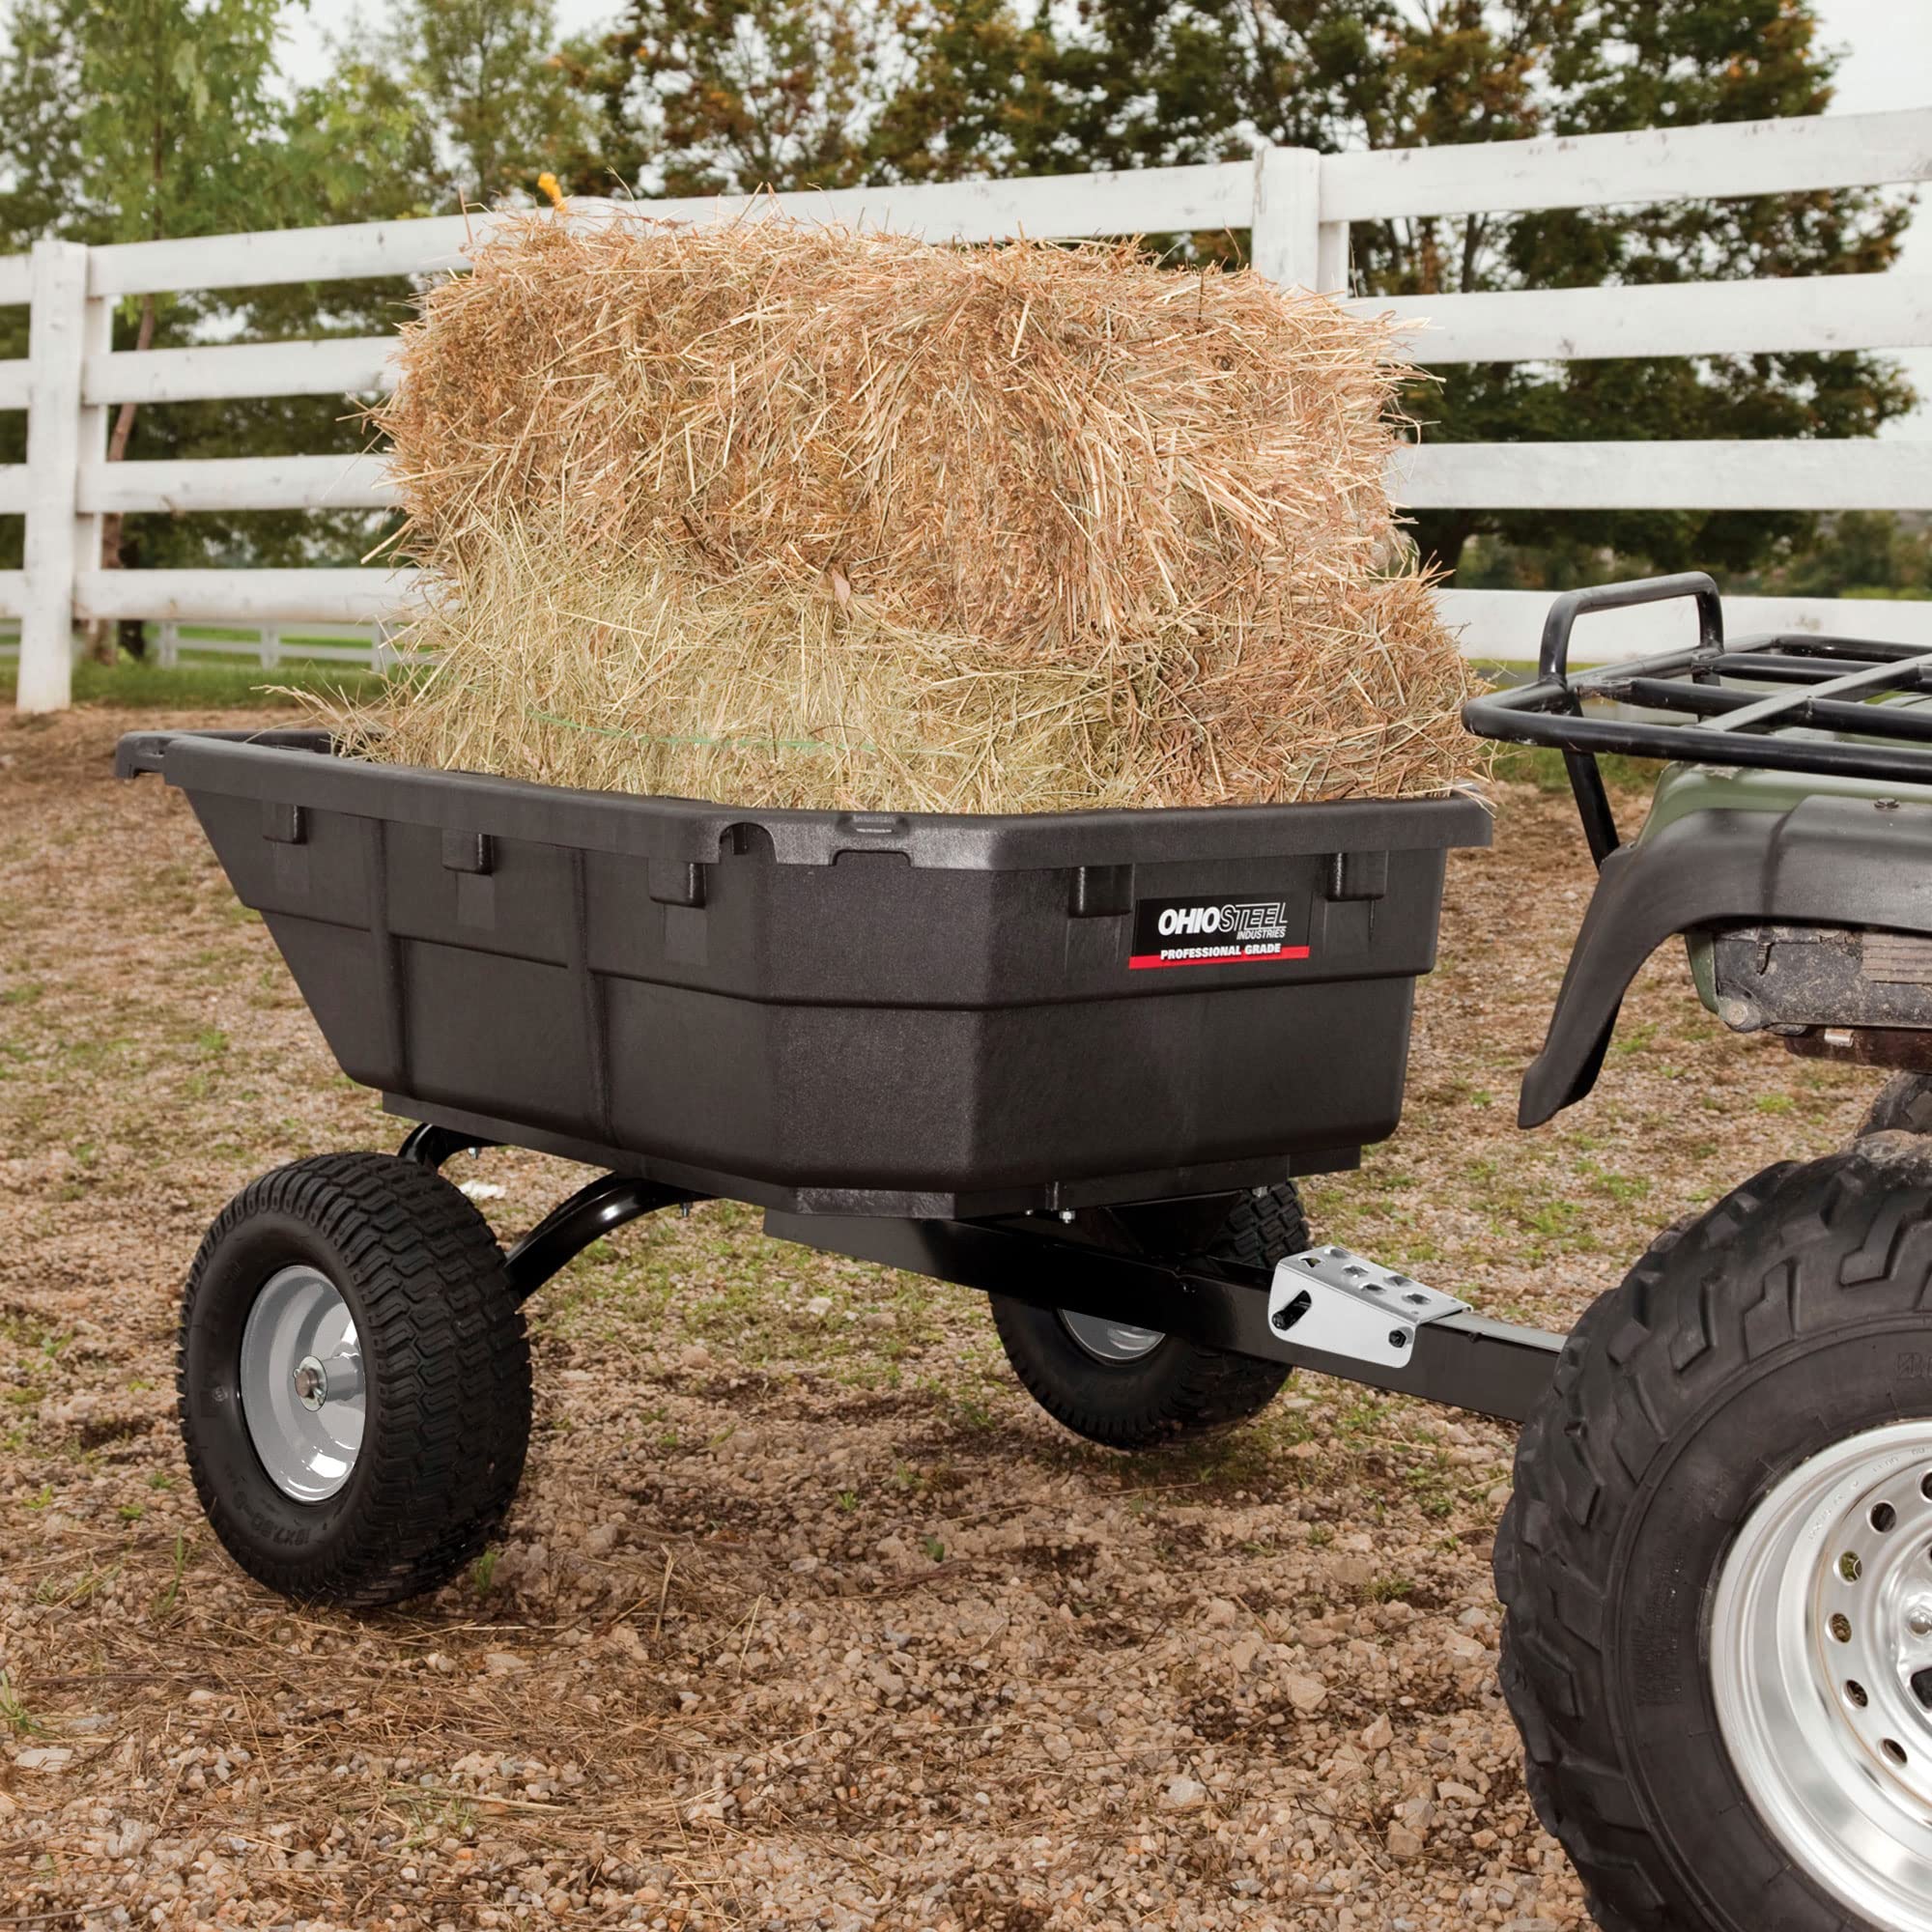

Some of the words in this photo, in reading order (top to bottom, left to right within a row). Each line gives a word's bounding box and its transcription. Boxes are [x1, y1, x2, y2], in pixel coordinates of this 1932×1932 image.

[1236, 928, 1286, 940] INDUSTRIES
[1160, 946, 1241, 960] PROFESSIONAL
[1244, 943, 1281, 955] GRADE
